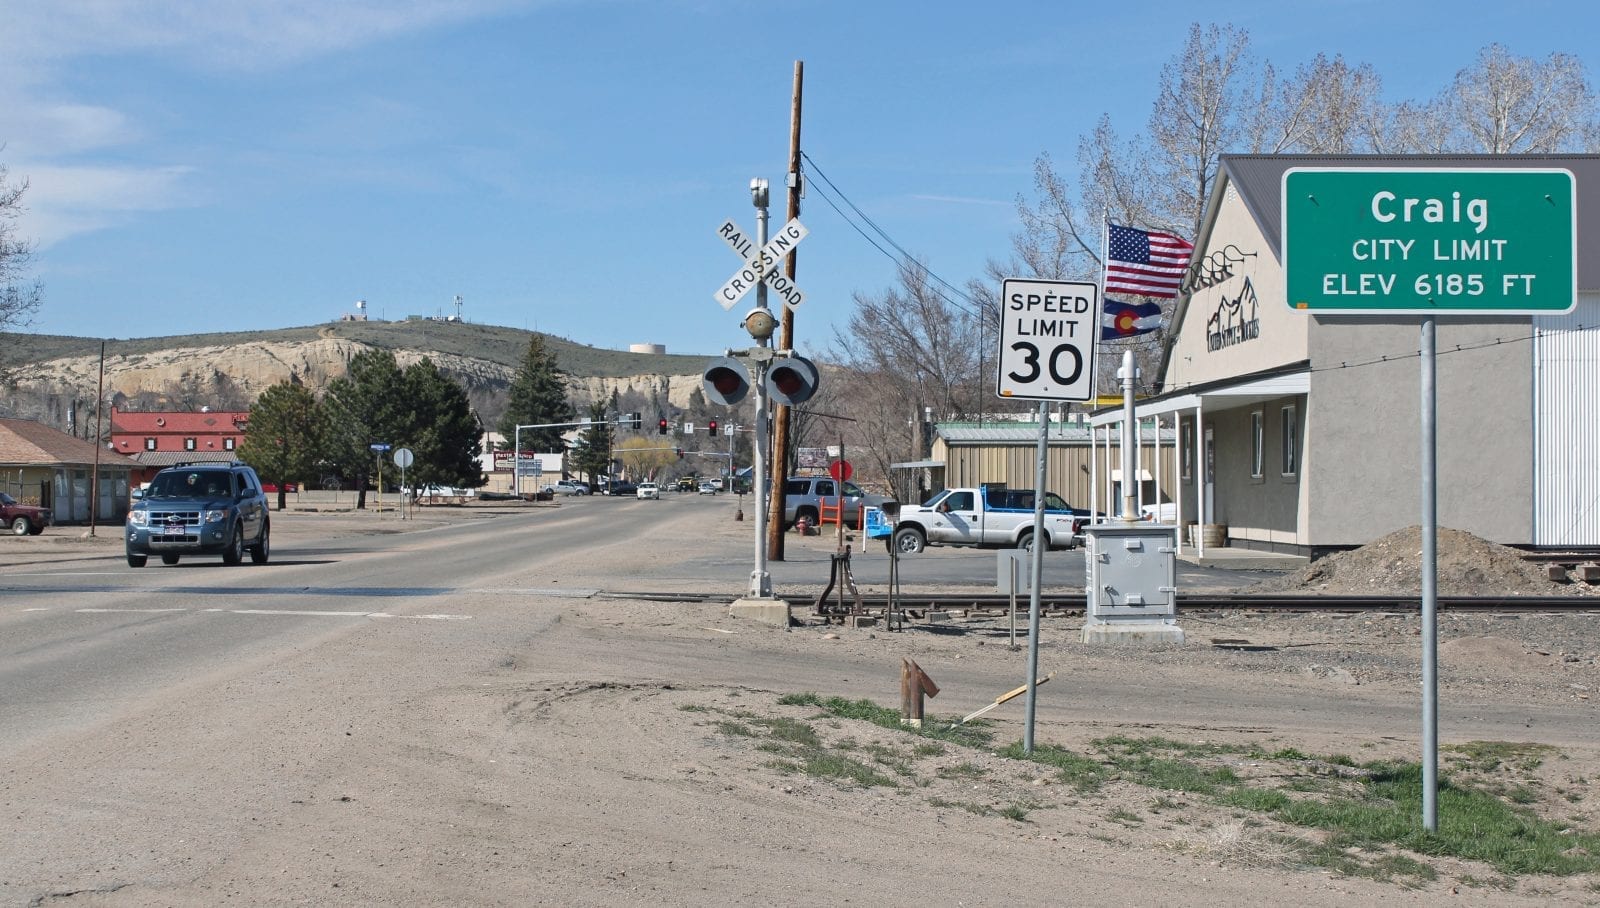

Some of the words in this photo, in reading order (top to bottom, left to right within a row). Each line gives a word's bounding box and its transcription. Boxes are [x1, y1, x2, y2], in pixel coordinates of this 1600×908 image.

[1371, 191, 1489, 234] Craig
[719, 222, 753, 258] RAIL
[766, 269, 802, 306] ROAD
[723, 225, 800, 302] CROSSING
[1352, 239, 1416, 261] CITY
[1434, 239, 1508, 261] LIMIT
[1322, 273, 1397, 295] ELEV
[1414, 273, 1485, 296] 6185
[1502, 274, 1536, 296] FT
[1010, 293, 1089, 314] SPEED
[1017, 318, 1079, 338] LIMIT
[1007, 341, 1083, 386] 30
